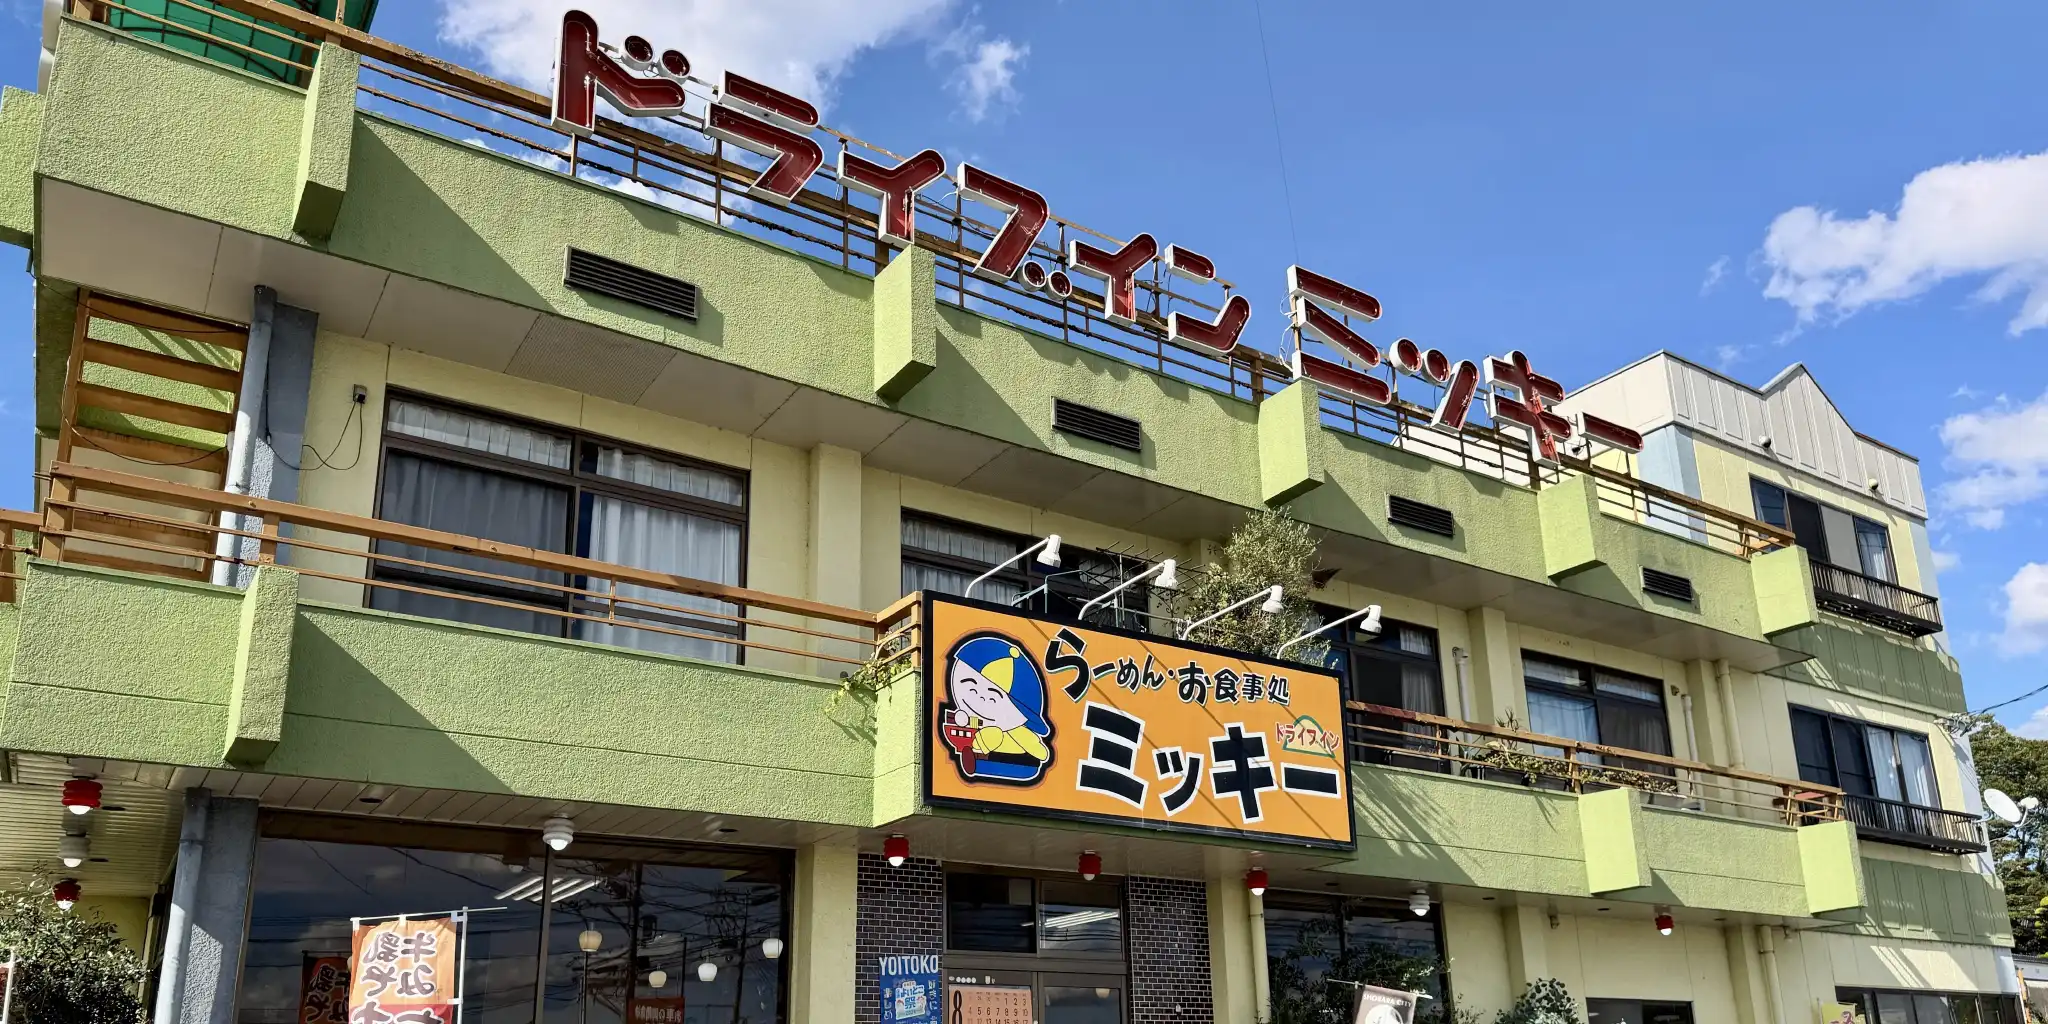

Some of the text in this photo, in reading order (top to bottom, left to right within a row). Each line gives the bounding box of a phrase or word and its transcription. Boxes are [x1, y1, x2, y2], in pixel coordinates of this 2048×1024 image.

[552, 9, 1644, 466] ドライブイン ミッキー
[1044, 626, 1290, 706] らーめん・お食事処
[1276, 722, 1340, 751] ドライブイン
[1077, 701, 1341, 823] ミッキー
[879, 954, 939, 976] YOITOKO
[977, 1006, 982, 1015] 5
[986, 1007, 991, 1016] 6
[1004, 1008, 1009, 1017] 8
[1013, 1008, 1018, 1017] 9
[1013, 997, 1018, 1006] 2
[1022, 998, 1027, 1007] 3
[1396, 998, 1412, 1008] CITY
